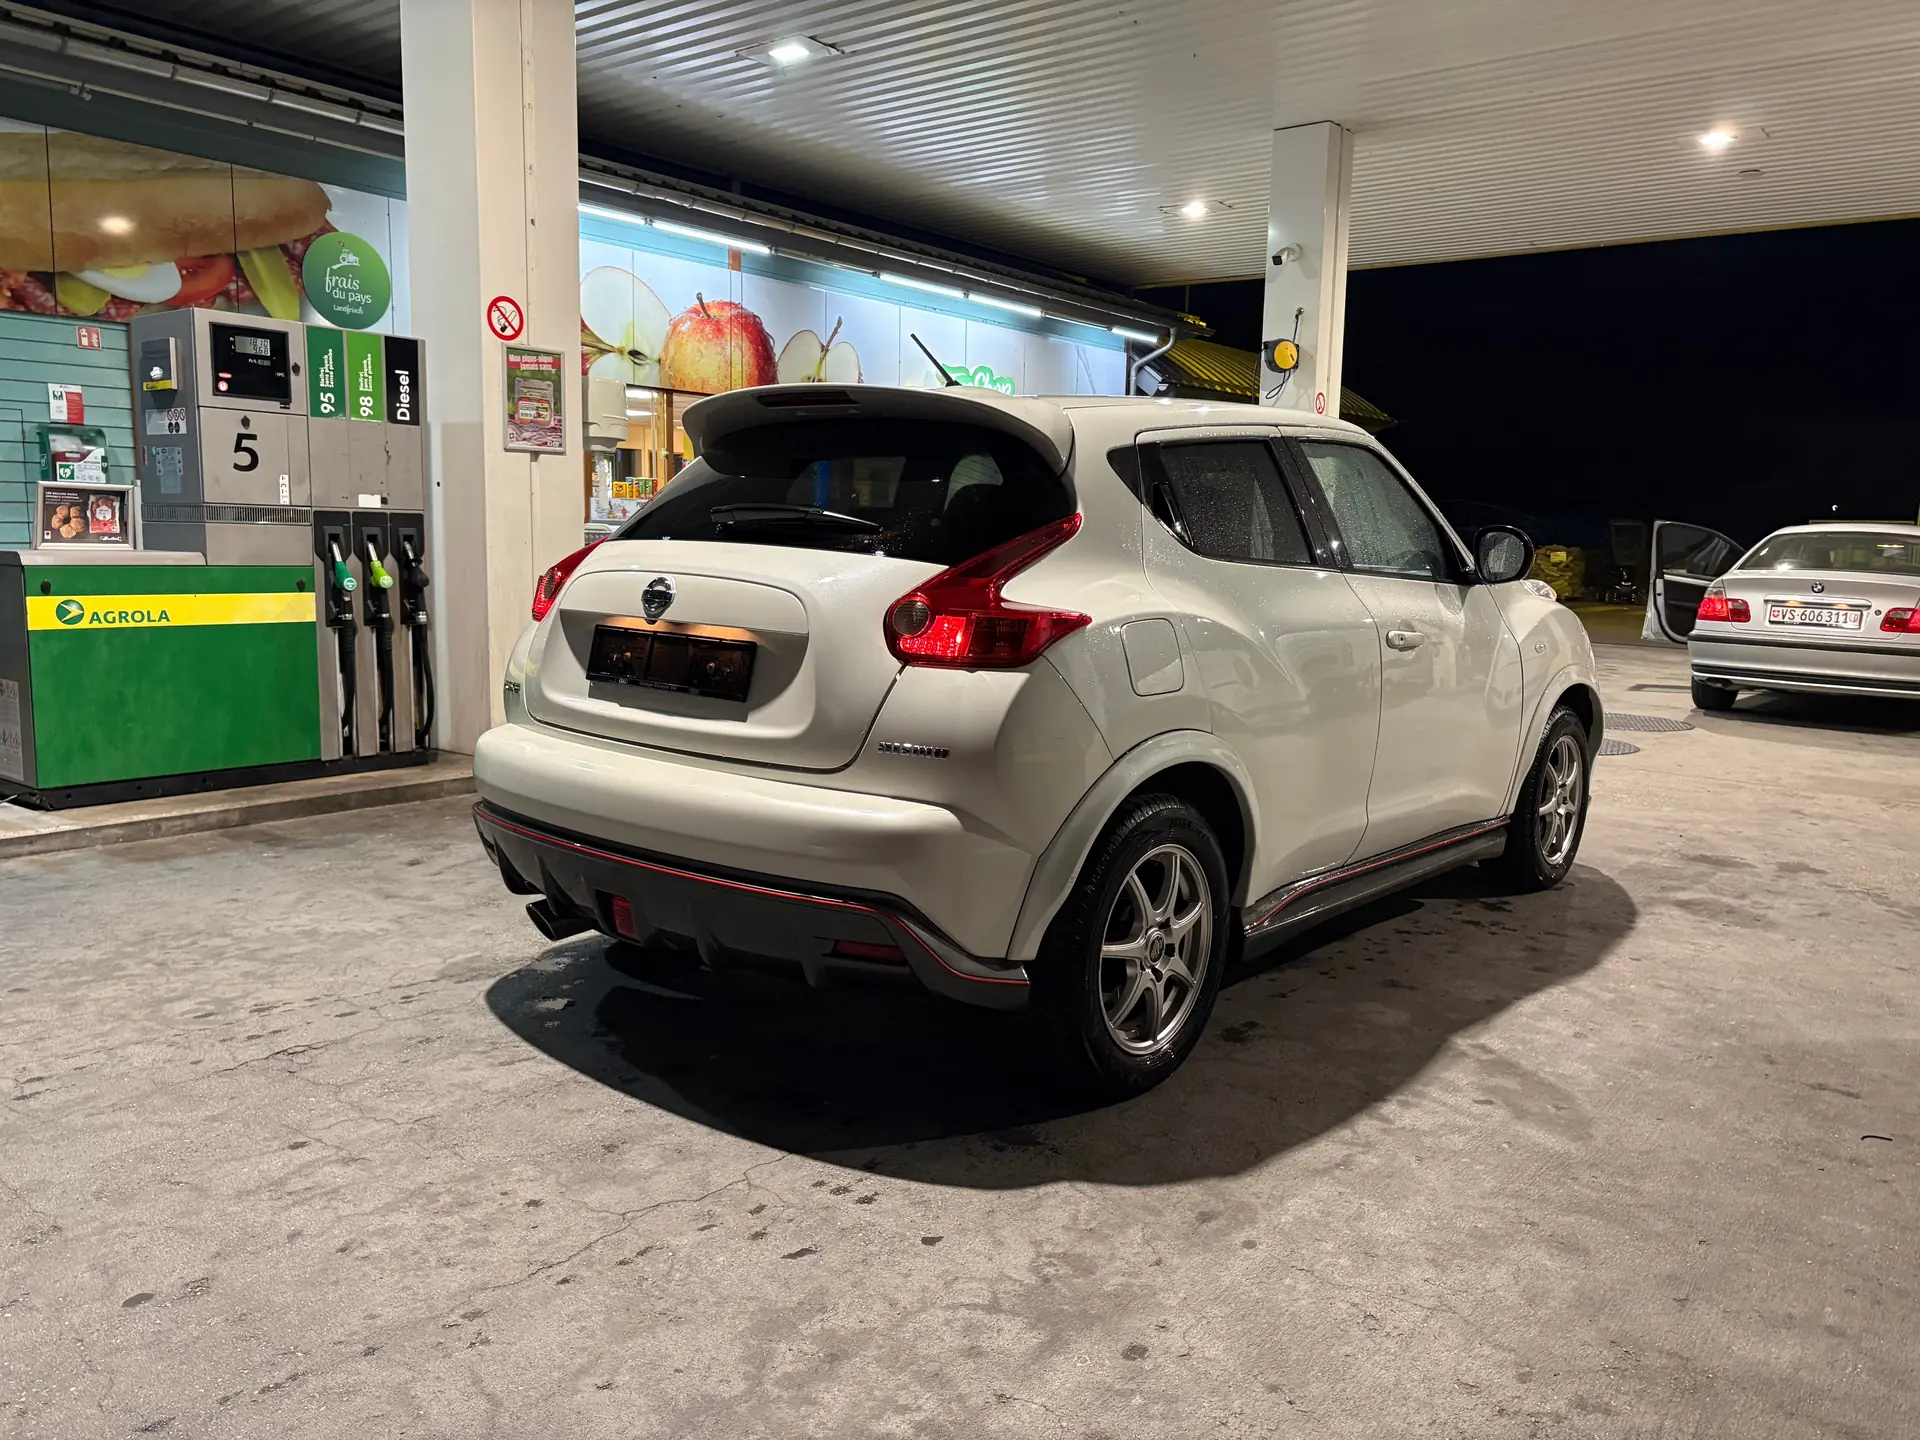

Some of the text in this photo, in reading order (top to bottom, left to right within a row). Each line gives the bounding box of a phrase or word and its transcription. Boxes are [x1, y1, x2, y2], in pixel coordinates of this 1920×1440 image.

[324, 267, 360, 293] frais
[332, 287, 372, 305] du pays
[320, 391, 335, 414] 95
[359, 396, 374, 417] 98
[394, 369, 410, 421] Diesel
[233, 432, 260, 472] 5
[89, 609, 171, 625] AGROLA
